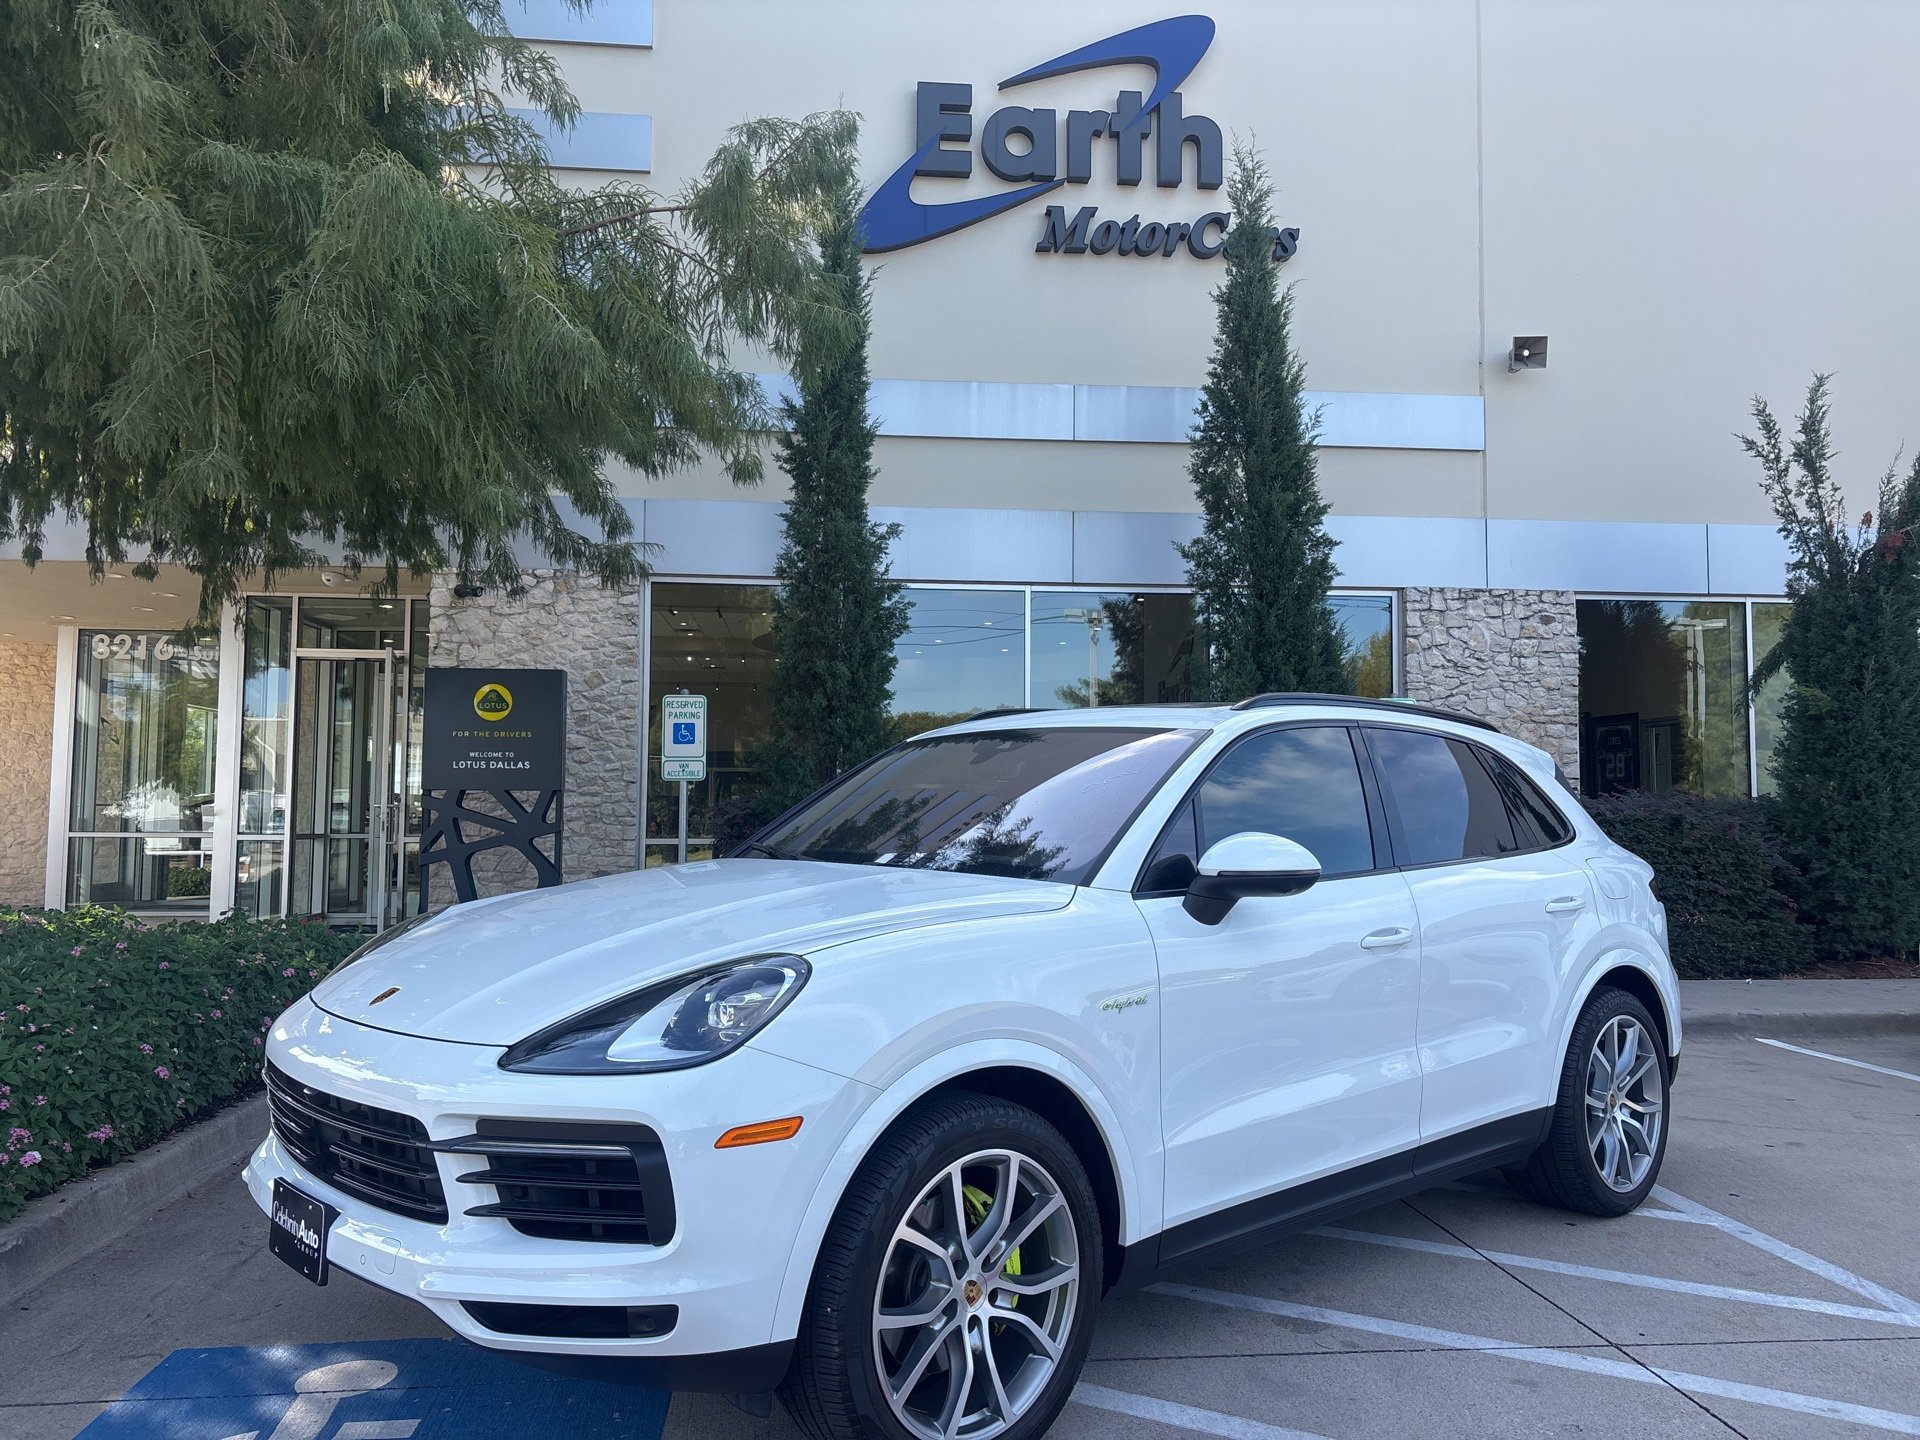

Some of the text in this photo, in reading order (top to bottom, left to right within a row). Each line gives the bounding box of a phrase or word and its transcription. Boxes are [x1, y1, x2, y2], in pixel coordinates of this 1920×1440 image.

[915, 81, 1224, 190] Earth
[1034, 205, 1300, 262] MotorCs
[92, 634, 174, 660] 8216
[666, 700, 704, 709] RESERVED
[668, 711, 701, 720] PARKING
[452, 760, 530, 769] LOTUS DALLAS
[297, 1242, 319, 1259] GROUP
